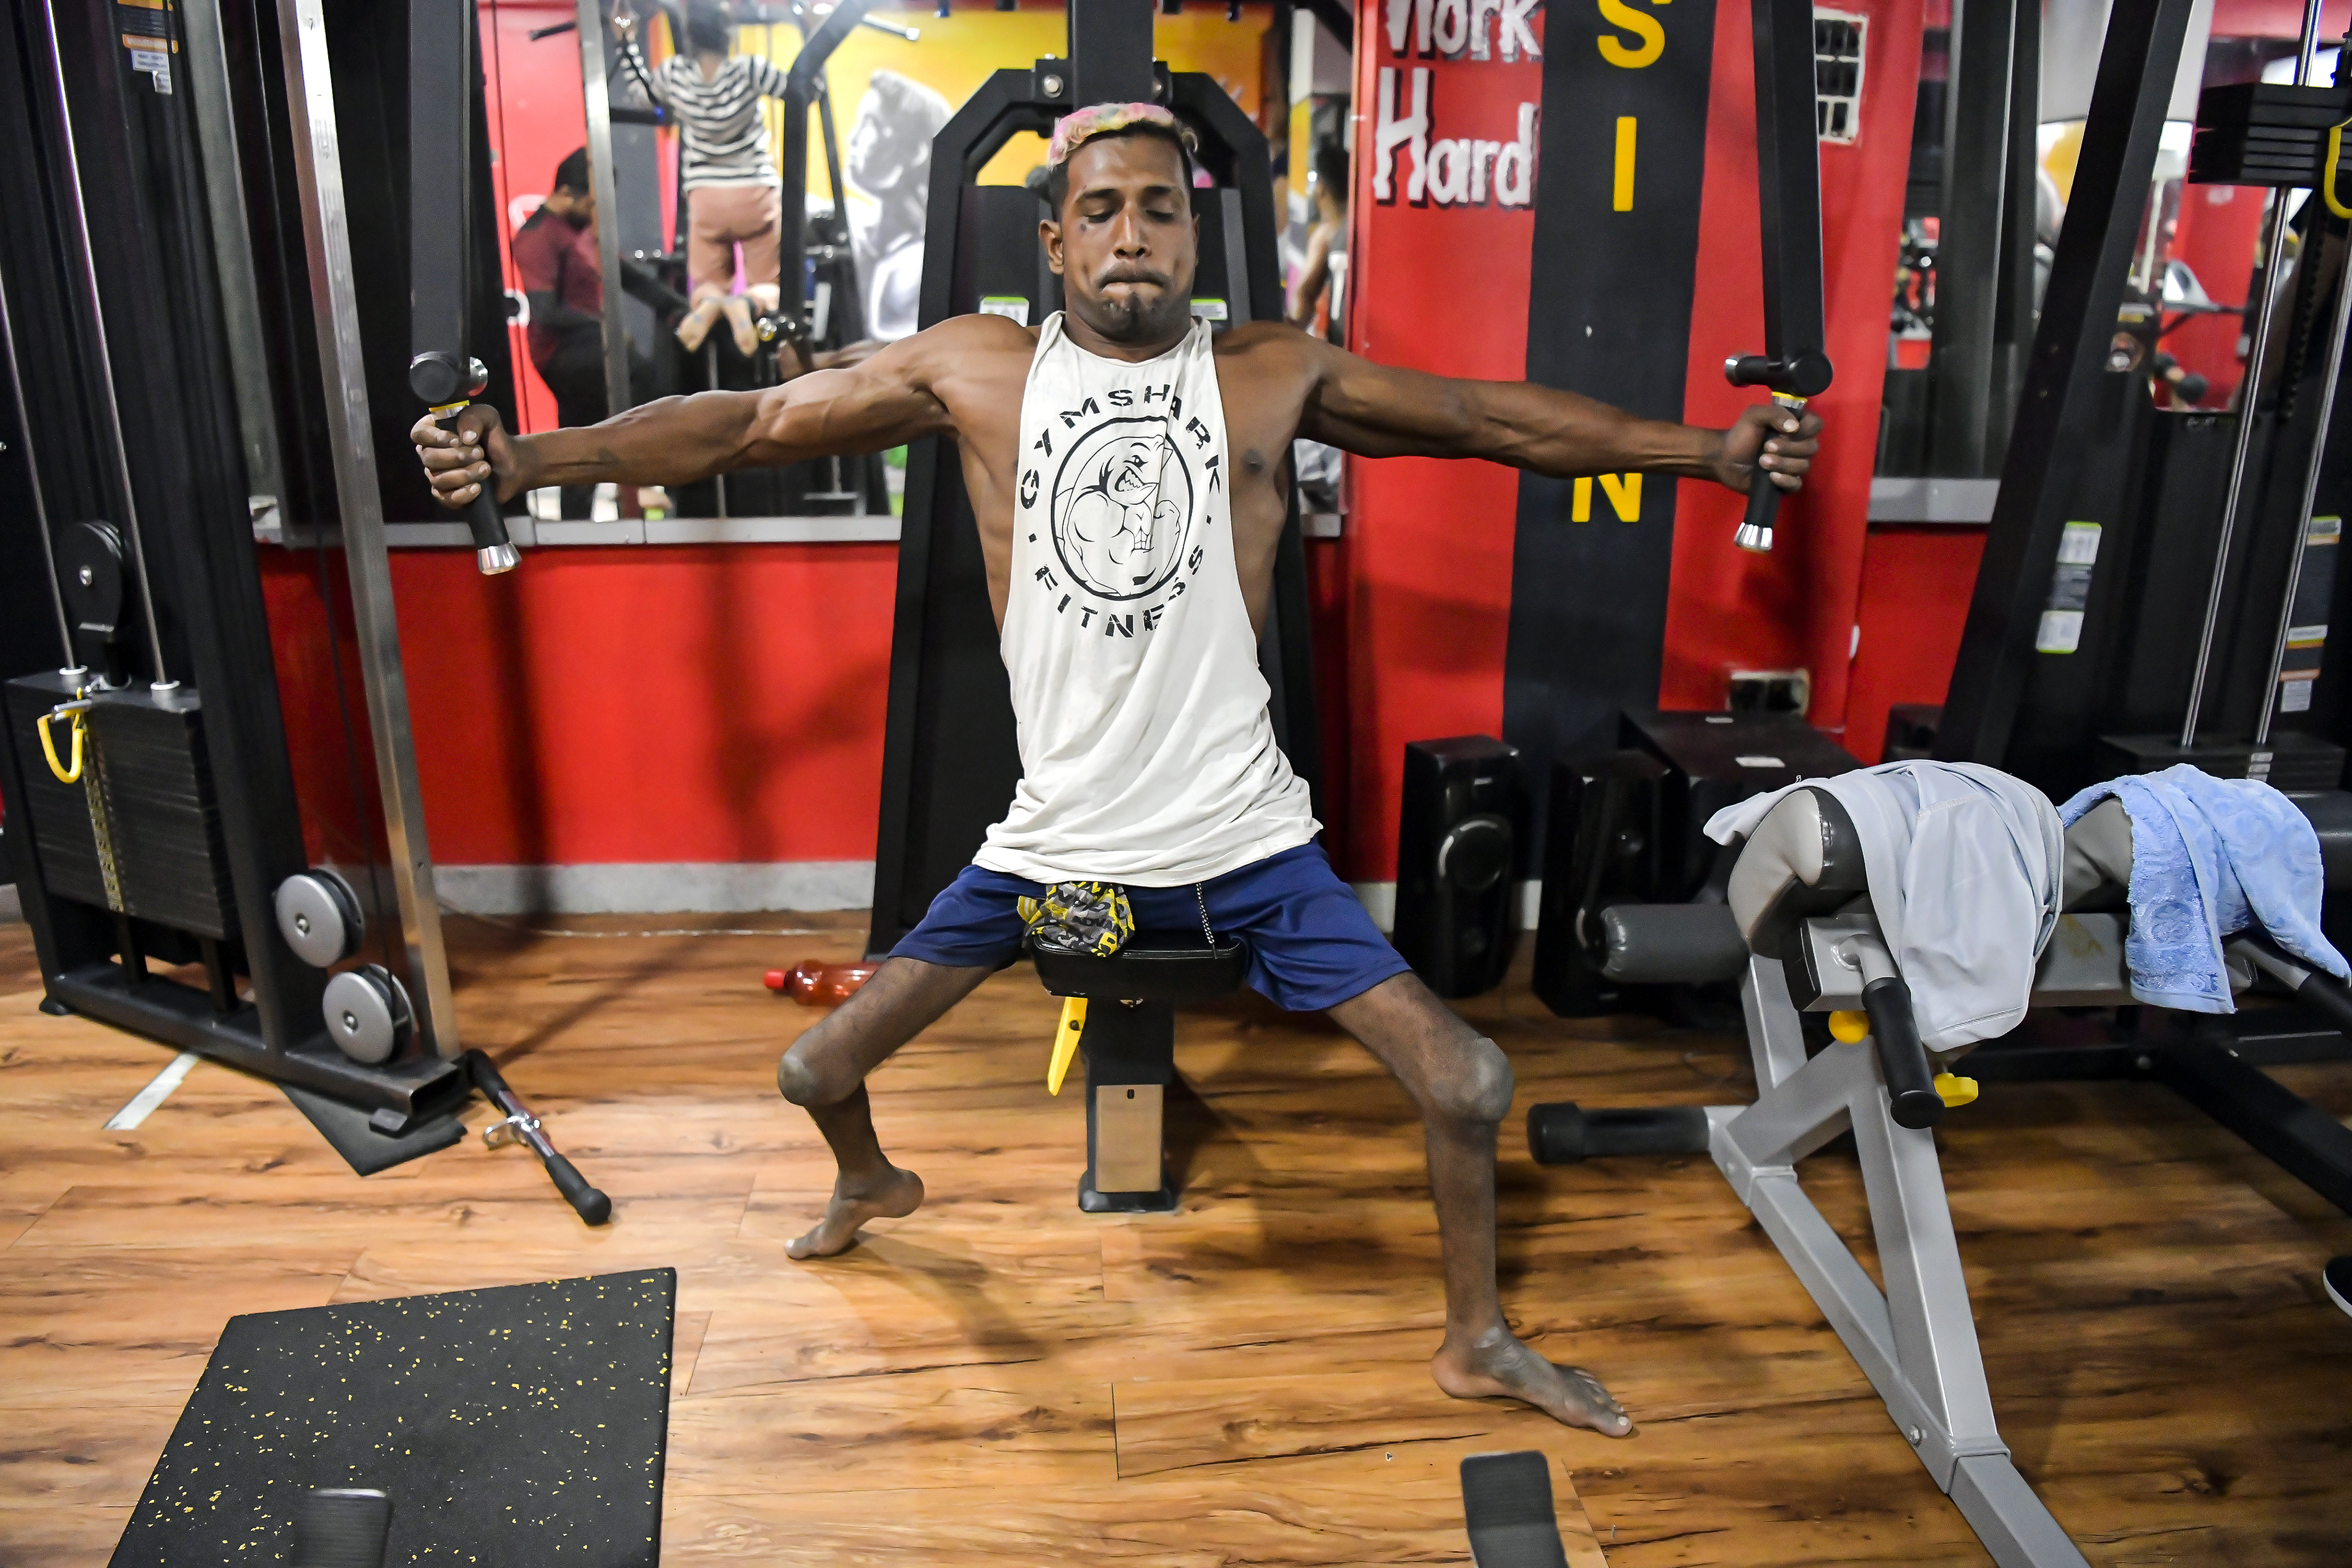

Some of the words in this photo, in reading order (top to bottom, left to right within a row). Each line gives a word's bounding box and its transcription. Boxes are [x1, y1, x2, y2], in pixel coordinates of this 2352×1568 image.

[1372, 66, 1540, 207] Hard
[1019, 384, 1221, 510] GYMSHARK
[1034, 544, 1204, 639] FITNESS
